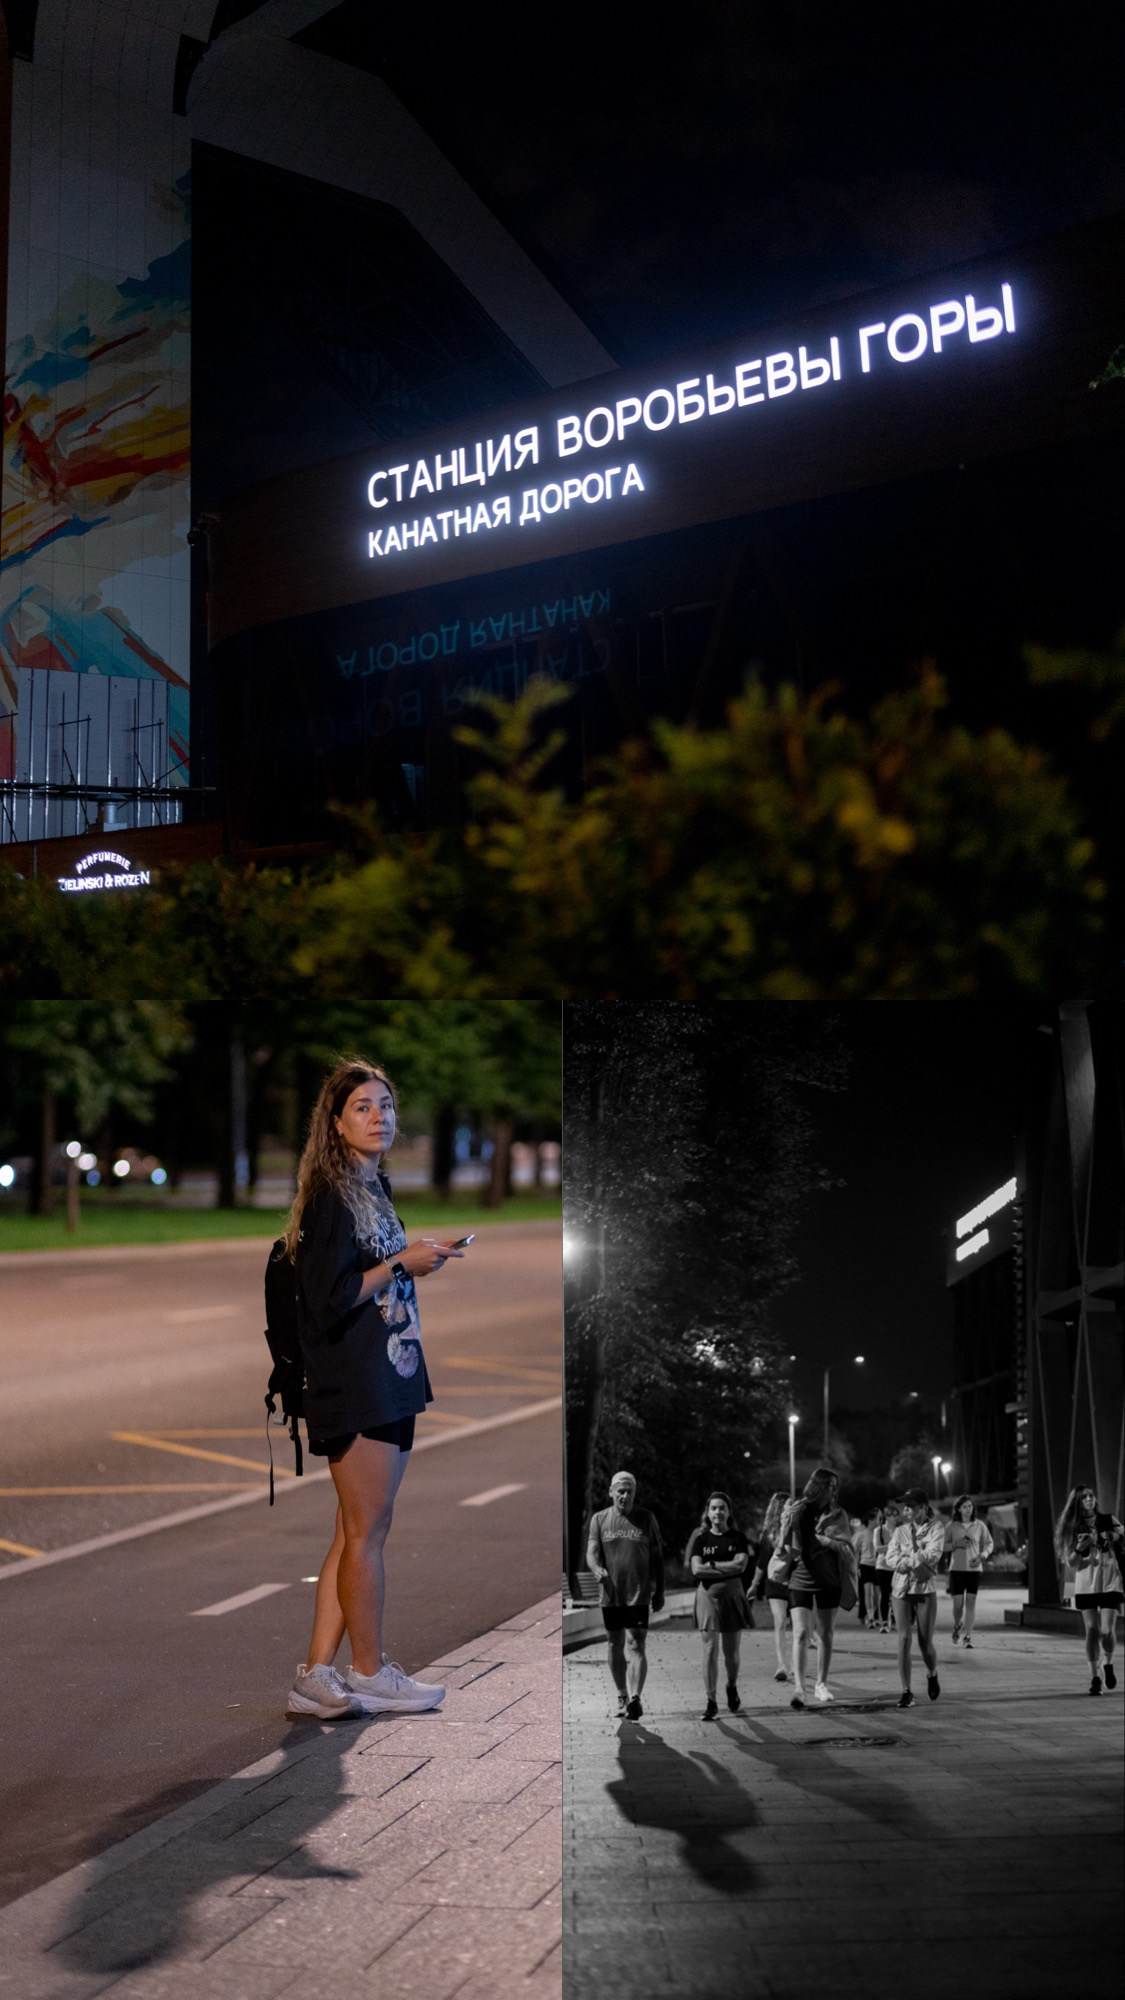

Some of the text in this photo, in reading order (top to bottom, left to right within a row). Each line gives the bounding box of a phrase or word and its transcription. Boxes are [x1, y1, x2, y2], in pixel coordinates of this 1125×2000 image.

[366, 282, 1017, 510] СТАНЦИЯ ВОРОБЬЕВЫ ГОРЫ
[367, 461, 646, 560] КАНАТНАЯ ДОРОГА
[75, 850, 132, 875] PERFUMERIE
[104, 872, 114, 889] &
[114, 870, 151, 887] ROZEN
